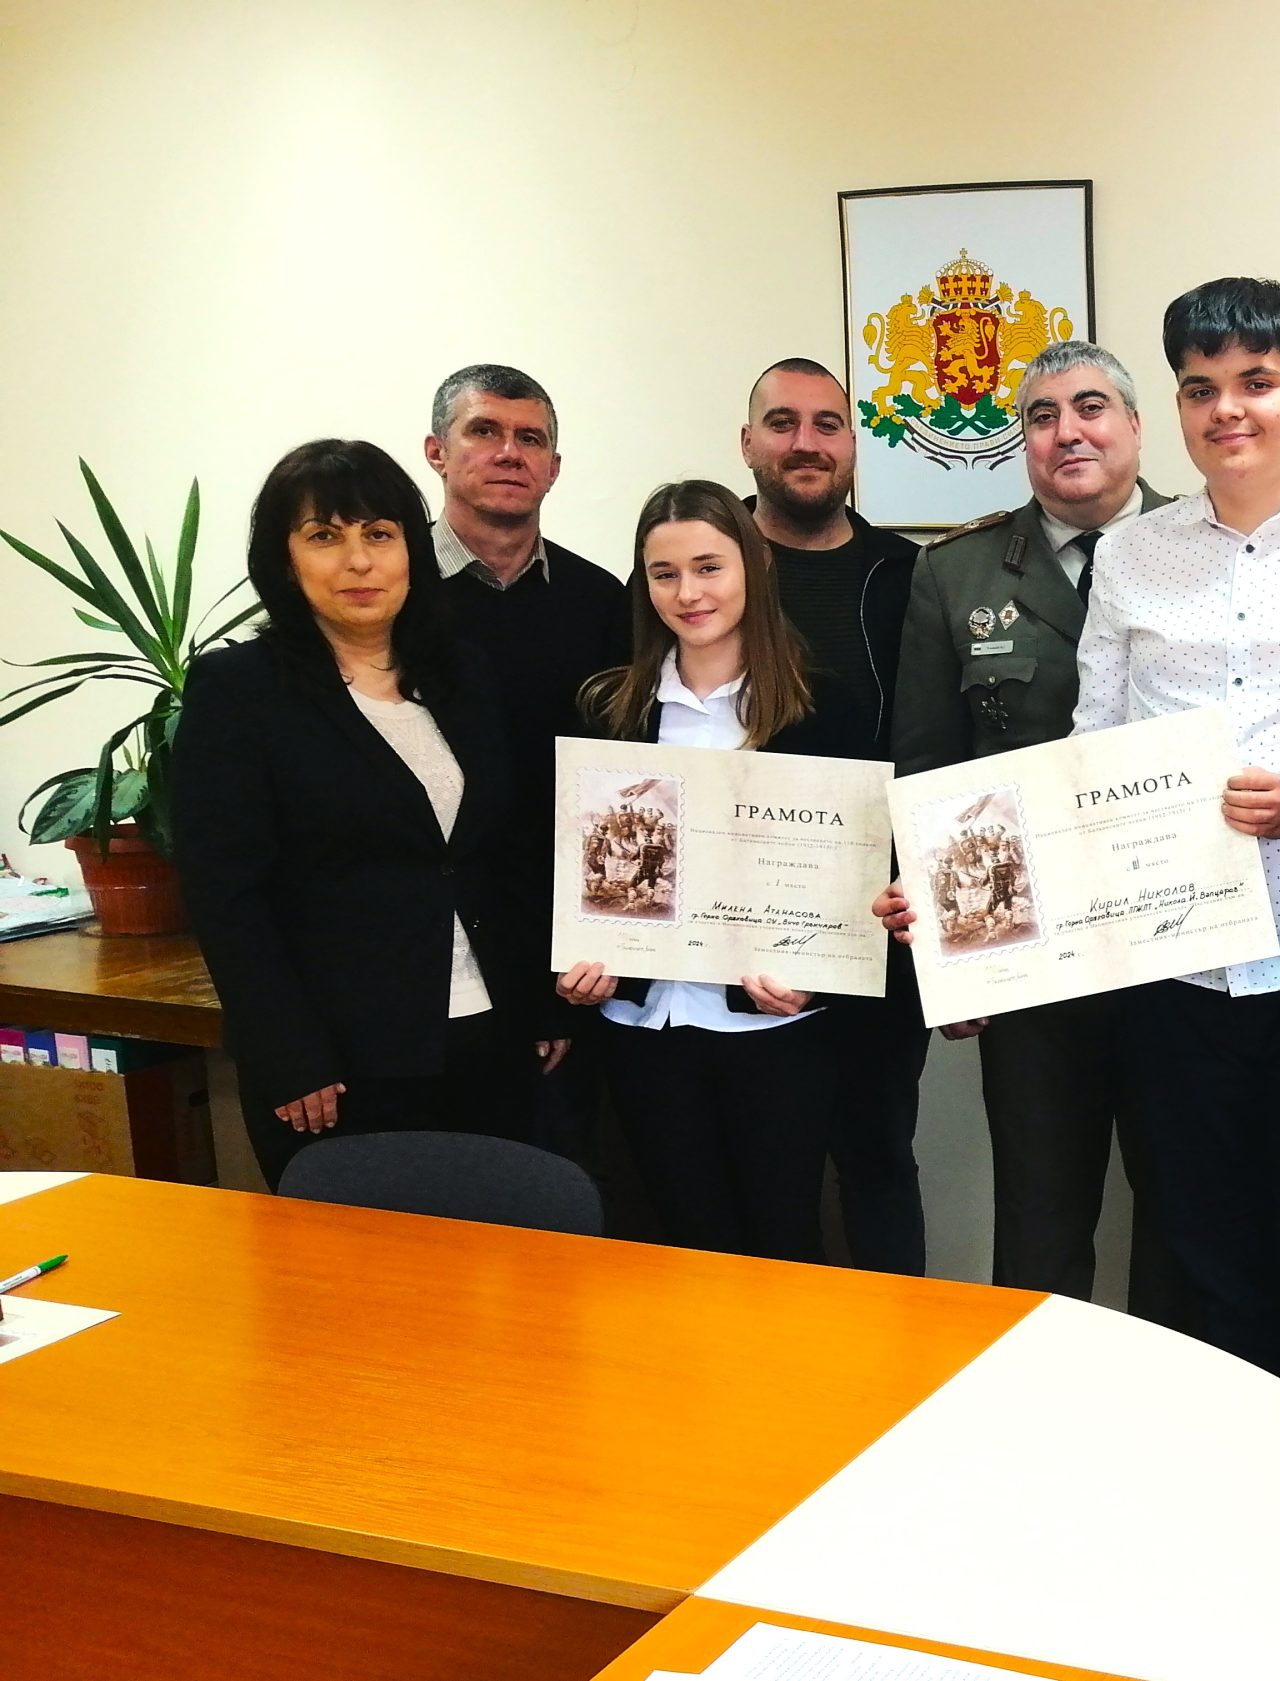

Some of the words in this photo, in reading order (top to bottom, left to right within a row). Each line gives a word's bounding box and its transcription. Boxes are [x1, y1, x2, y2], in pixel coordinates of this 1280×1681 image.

[1074, 771, 1192, 809] ГРАМОТА
[734, 804, 844, 826] ГРАМОТА
[1112, 832, 1177, 852] Награждава
[758, 857, 819, 870] Награждава
